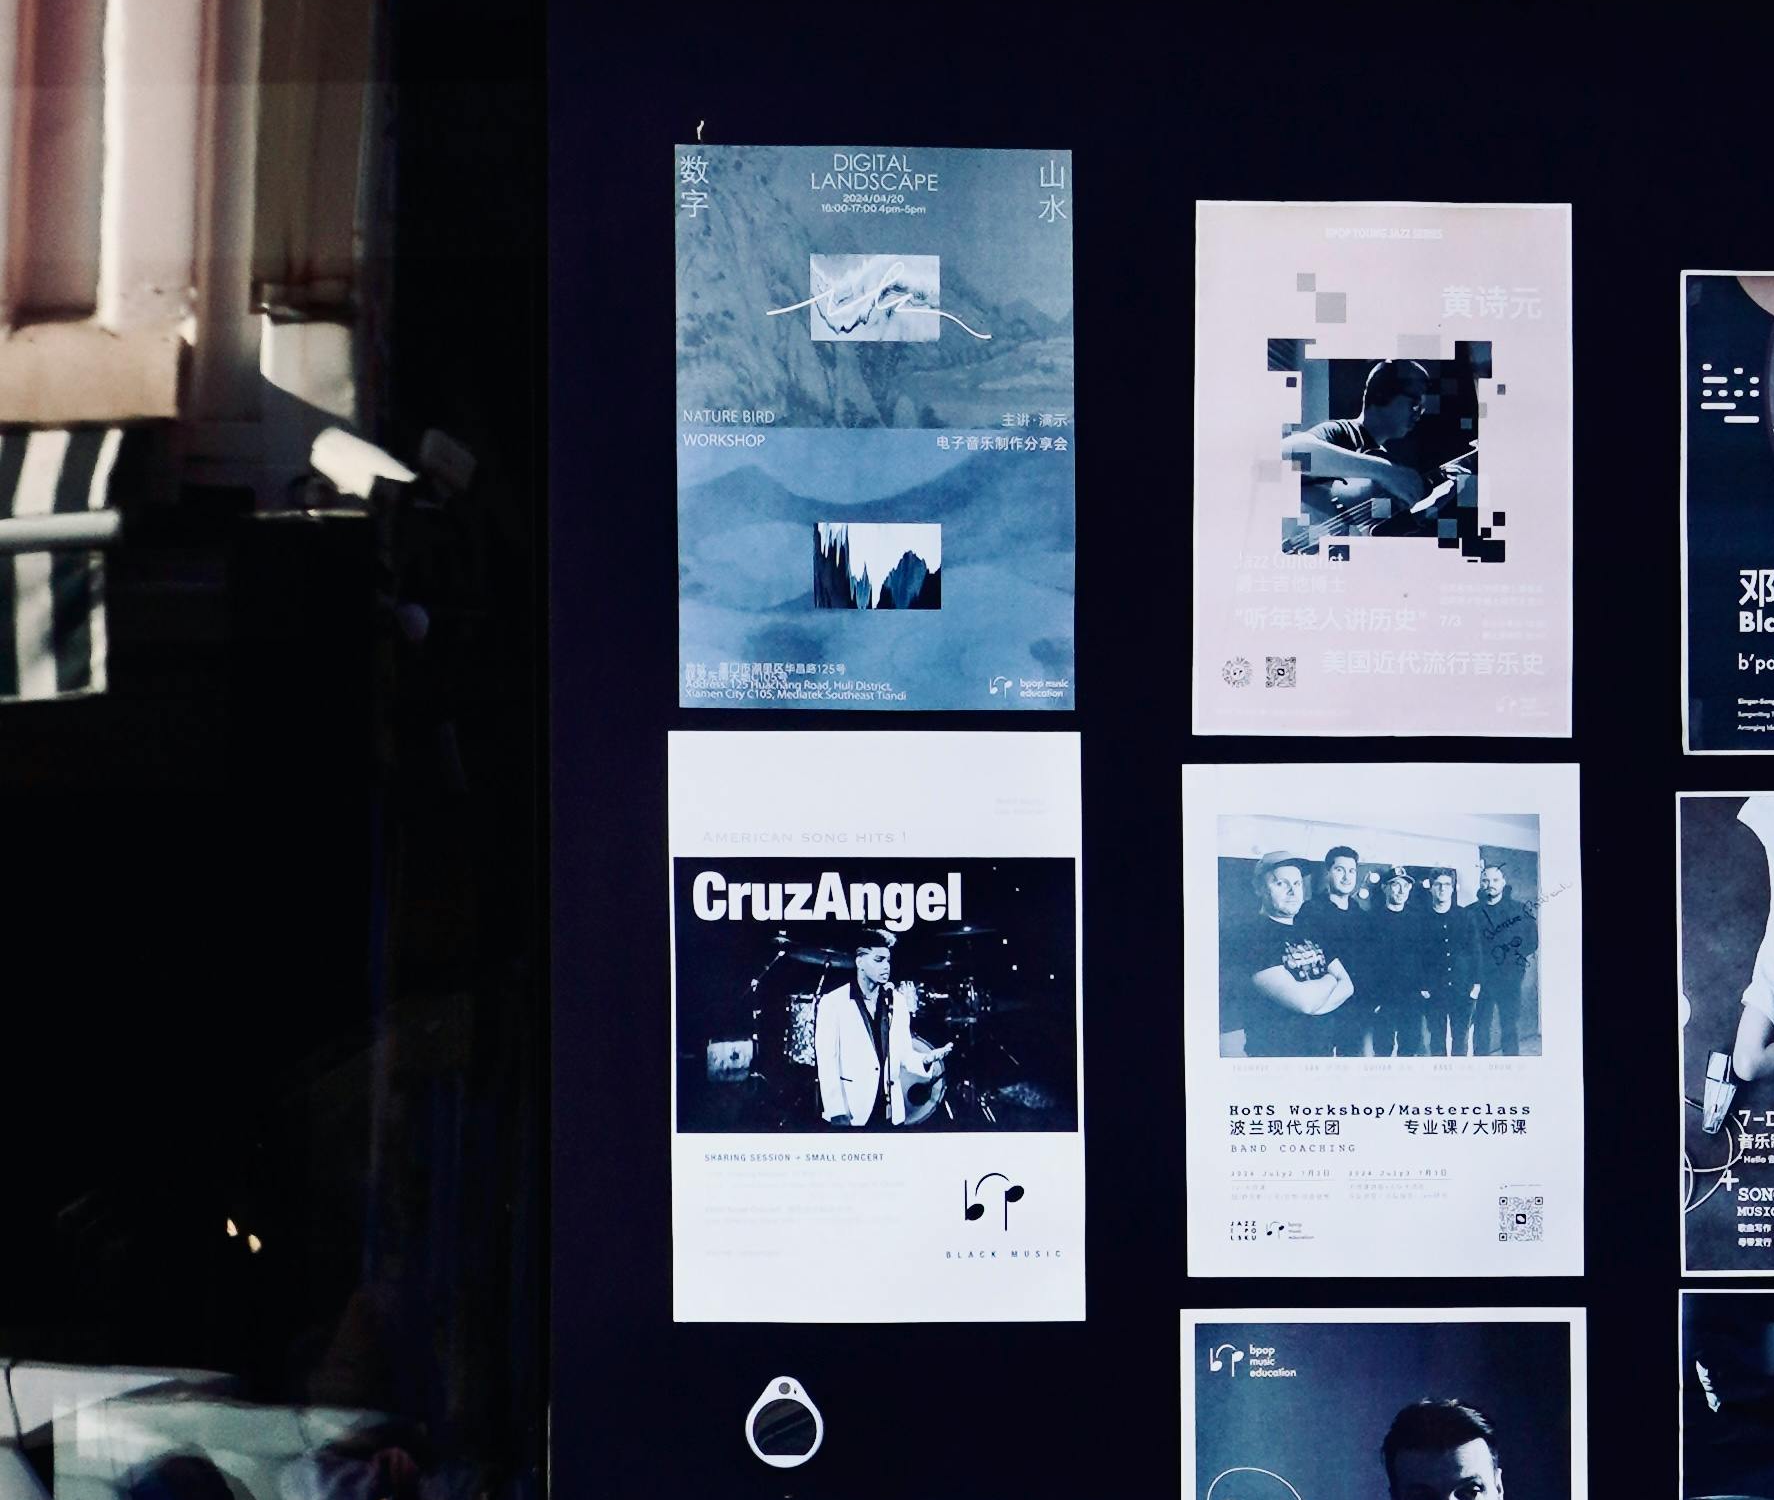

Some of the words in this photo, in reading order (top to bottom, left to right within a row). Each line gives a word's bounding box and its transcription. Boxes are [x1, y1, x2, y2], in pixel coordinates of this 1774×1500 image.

[833, 153, 912, 172] DIGITAL
[681, 155, 708, 218] 数字
[811, 172, 939, 192] LANDSCAPE
[843, 194, 904, 203] 2024/04/20
[1038, 161, 1067, 222] 山水
[1441, 286, 1542, 320] 黄诗元
[684, 409, 739, 423] NATURE
[742, 410, 775, 424] BIRD
[684, 434, 765, 448] WORKSHOP
[936, 436, 1068, 451] 电子音乐制作分享会
[1322, 650, 1545, 676] 美国近代流行音乐史
[725, 690, 745, 700] City
[825, 691, 874, 700] Southeast
[692, 870, 962, 932] CruzAngel
[1229, 1105, 1276, 1115] HoTS
[1290, 1104, 1532, 1118] Workshop/Masterclass
[1229, 1118, 1341, 1136] 波兰现代乐团
[1403, 1118, 1528, 1136] 专业课/大师课
[1231, 1144, 1268, 1153] BAND
[1279, 1144, 1356, 1153] COACHING
[704, 1153, 747, 1162] SHARING
[750, 1153, 791, 1162] SESSION
[806, 1153, 837, 1162] SMALL
[841, 1152, 885, 1161] CONCERT
[946, 1250, 998, 1259] BLACK
[1011, 1249, 1062, 1259] MUSIC
[1250, 1344, 1276, 1359] bpop
[1250, 1356, 1275, 1366] music
[1250, 1367, 1297, 1378] education
